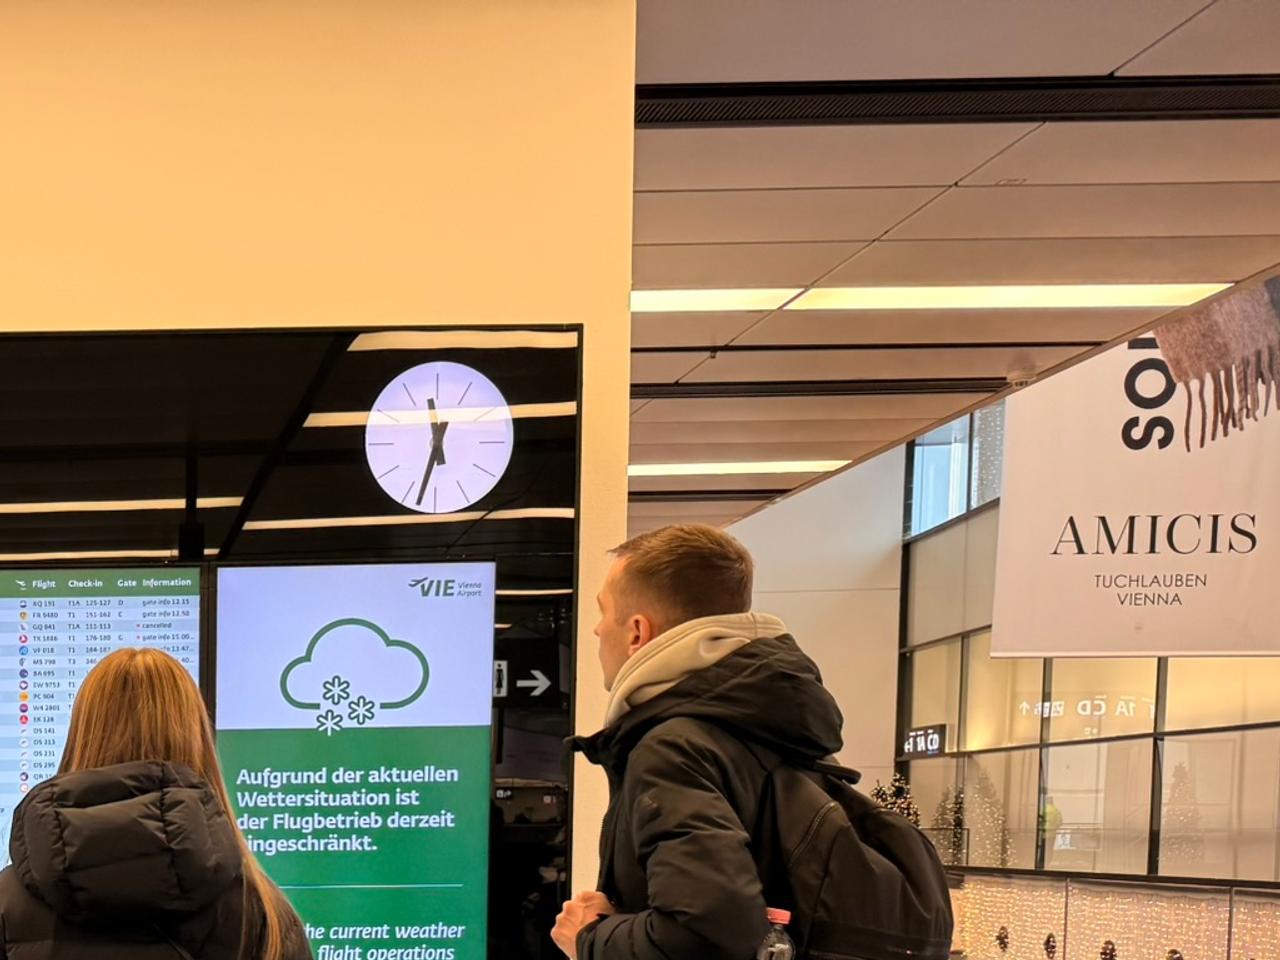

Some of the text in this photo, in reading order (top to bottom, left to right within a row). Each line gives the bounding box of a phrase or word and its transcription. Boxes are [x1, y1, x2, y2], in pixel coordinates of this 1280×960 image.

[1050, 512, 1258, 555] AMICIS
[32, 579, 56, 590] Flight
[68, 579, 104, 588] Check-in
[116, 579, 138, 587] Gate
[142, 577, 192, 588] Information
[417, 580, 455, 596] VIE
[1095, 573, 1207, 588] TUCHLAUBEN
[1118, 592, 1183, 607] VIENNA
[142, 621, 172, 629] cancelled
[237, 766, 459, 788] Aufgrund der aktuellen
[237, 788, 420, 807] Wettersituation ist
[237, 810, 455, 833] der Flugbetrieb derzeit
[245, 834, 377, 856] ingeschränkt.
[304, 922, 465, 939] he current weather
